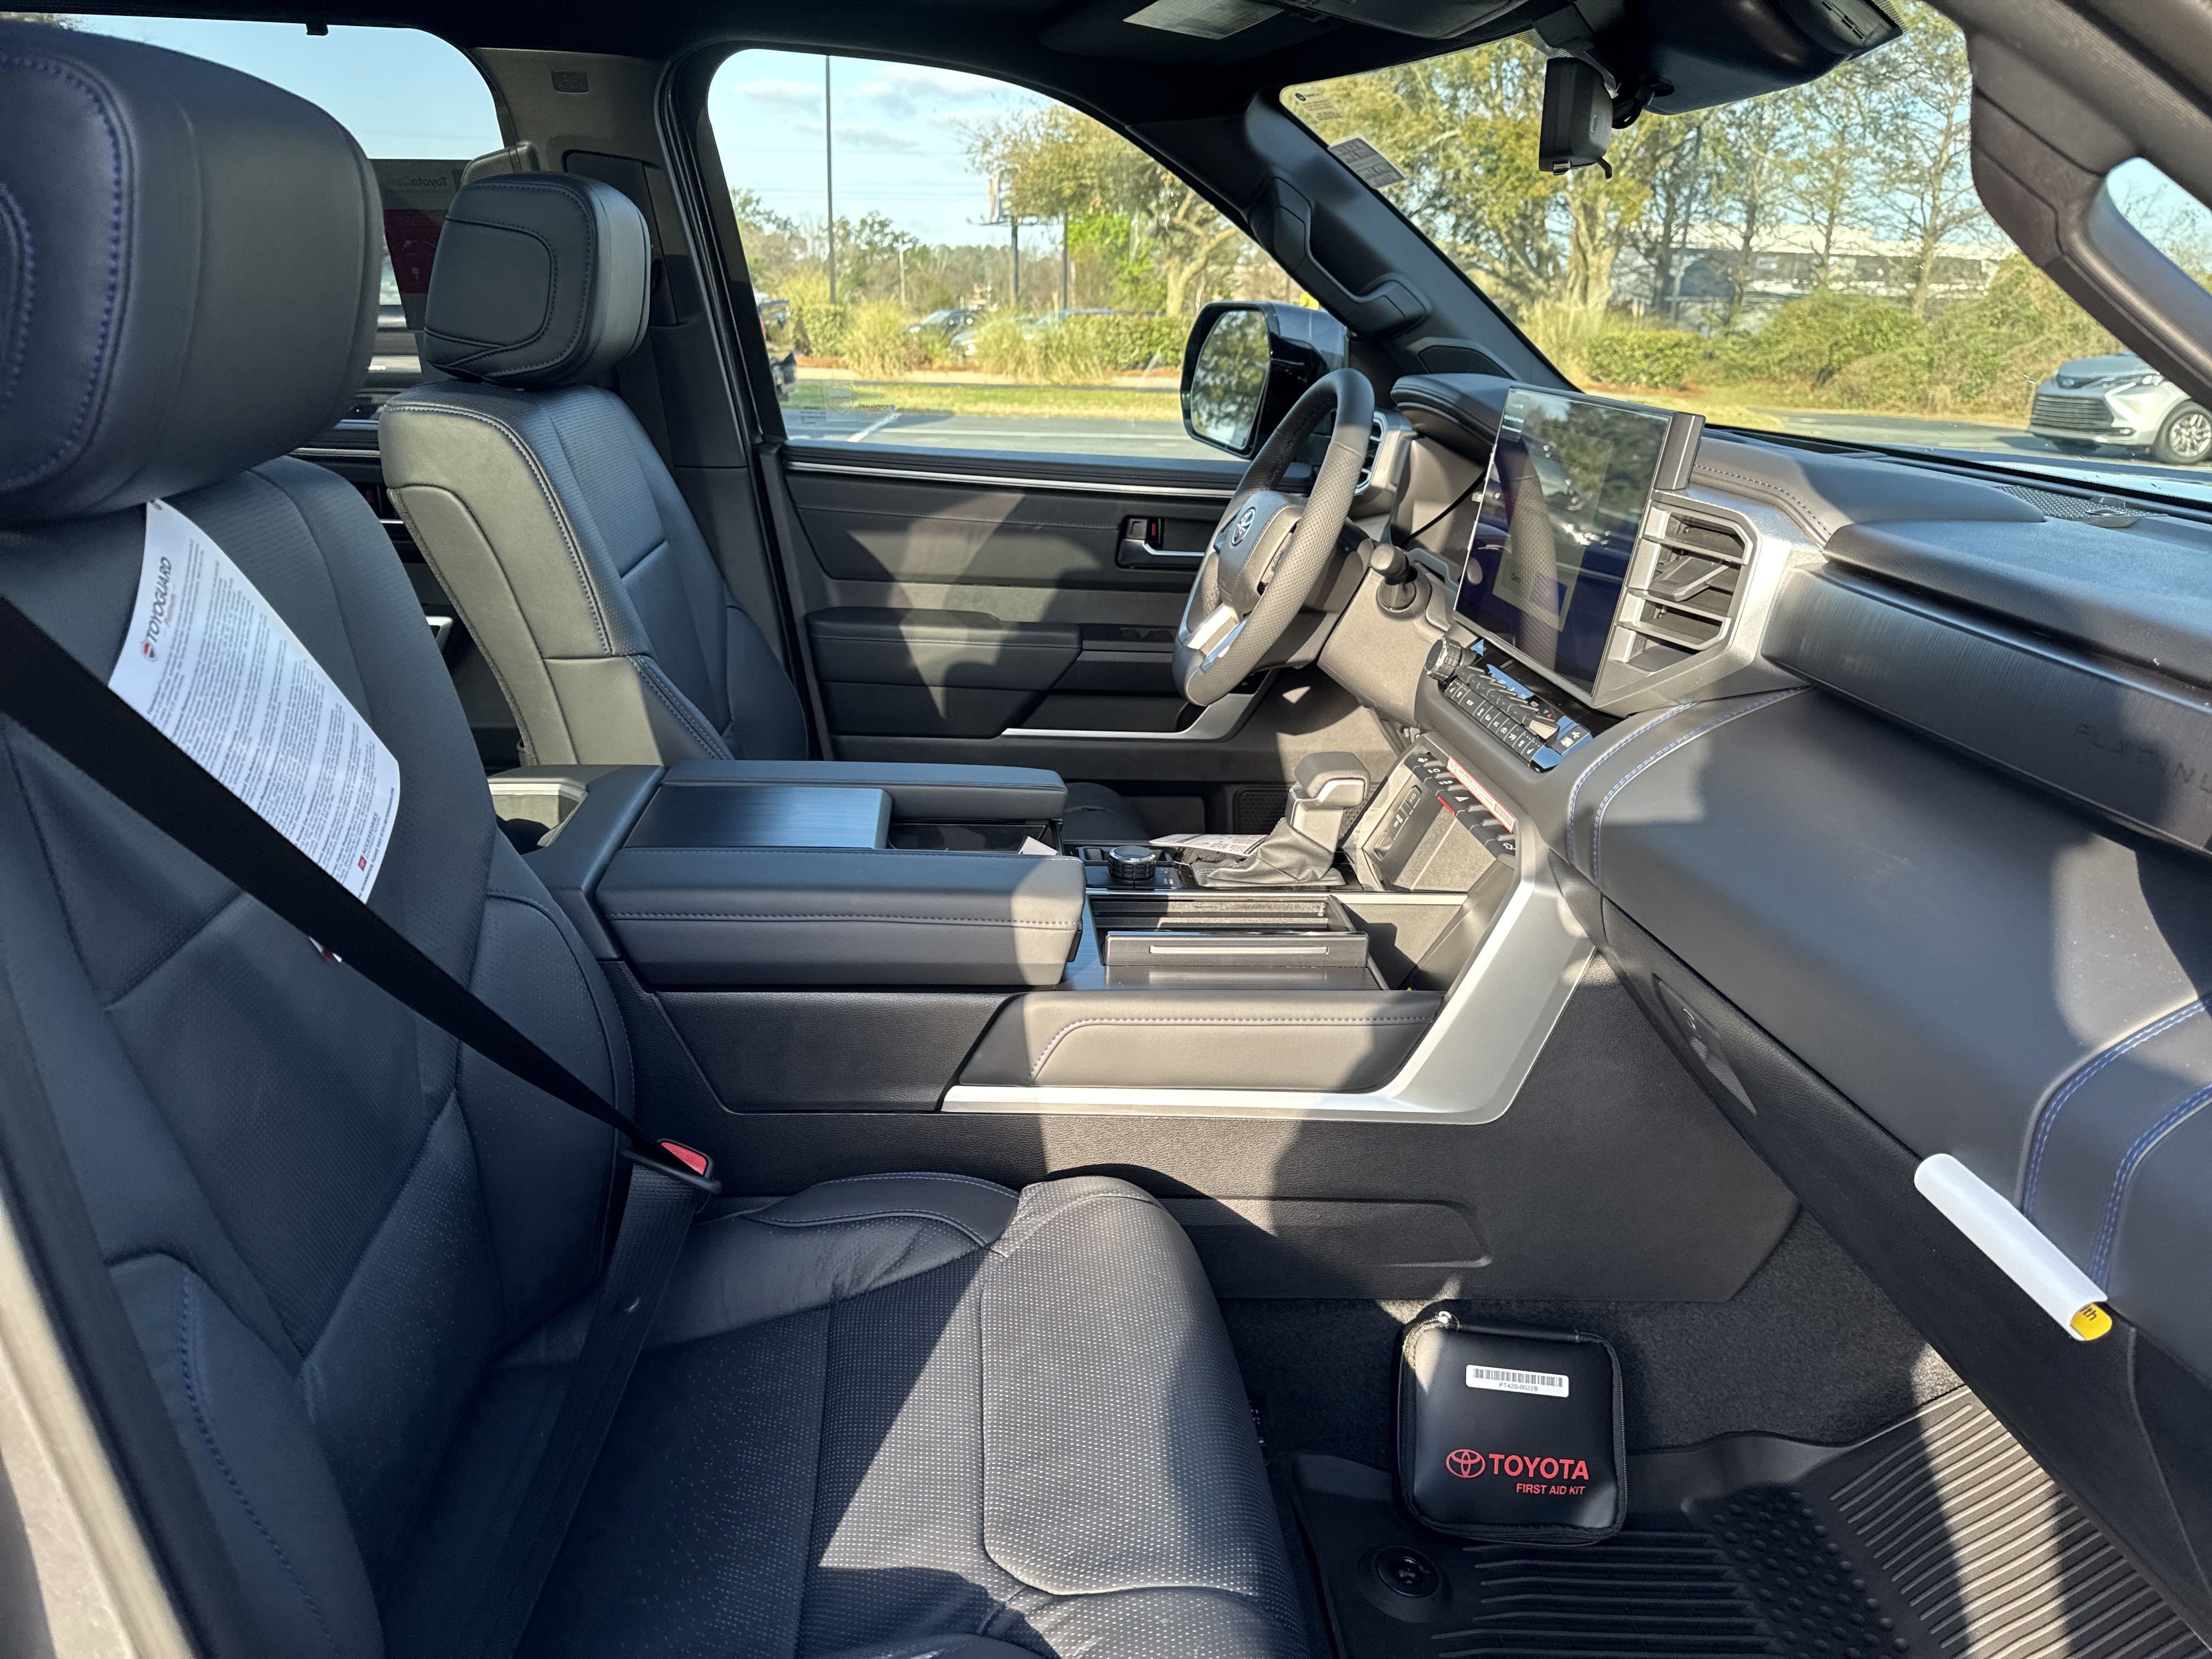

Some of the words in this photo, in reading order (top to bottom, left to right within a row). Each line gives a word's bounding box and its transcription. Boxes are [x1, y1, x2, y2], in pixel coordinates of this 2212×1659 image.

[145, 556, 171, 642] TOYOGUARD
[362, 812, 377, 856] ACCESSORIES
[1489, 1453, 1589, 1480] TOYOTA
[1516, 1483, 1547, 1494] FIRST
[1549, 1485, 1567, 1495] AID
[1569, 1486, 1586, 1496] KIT
